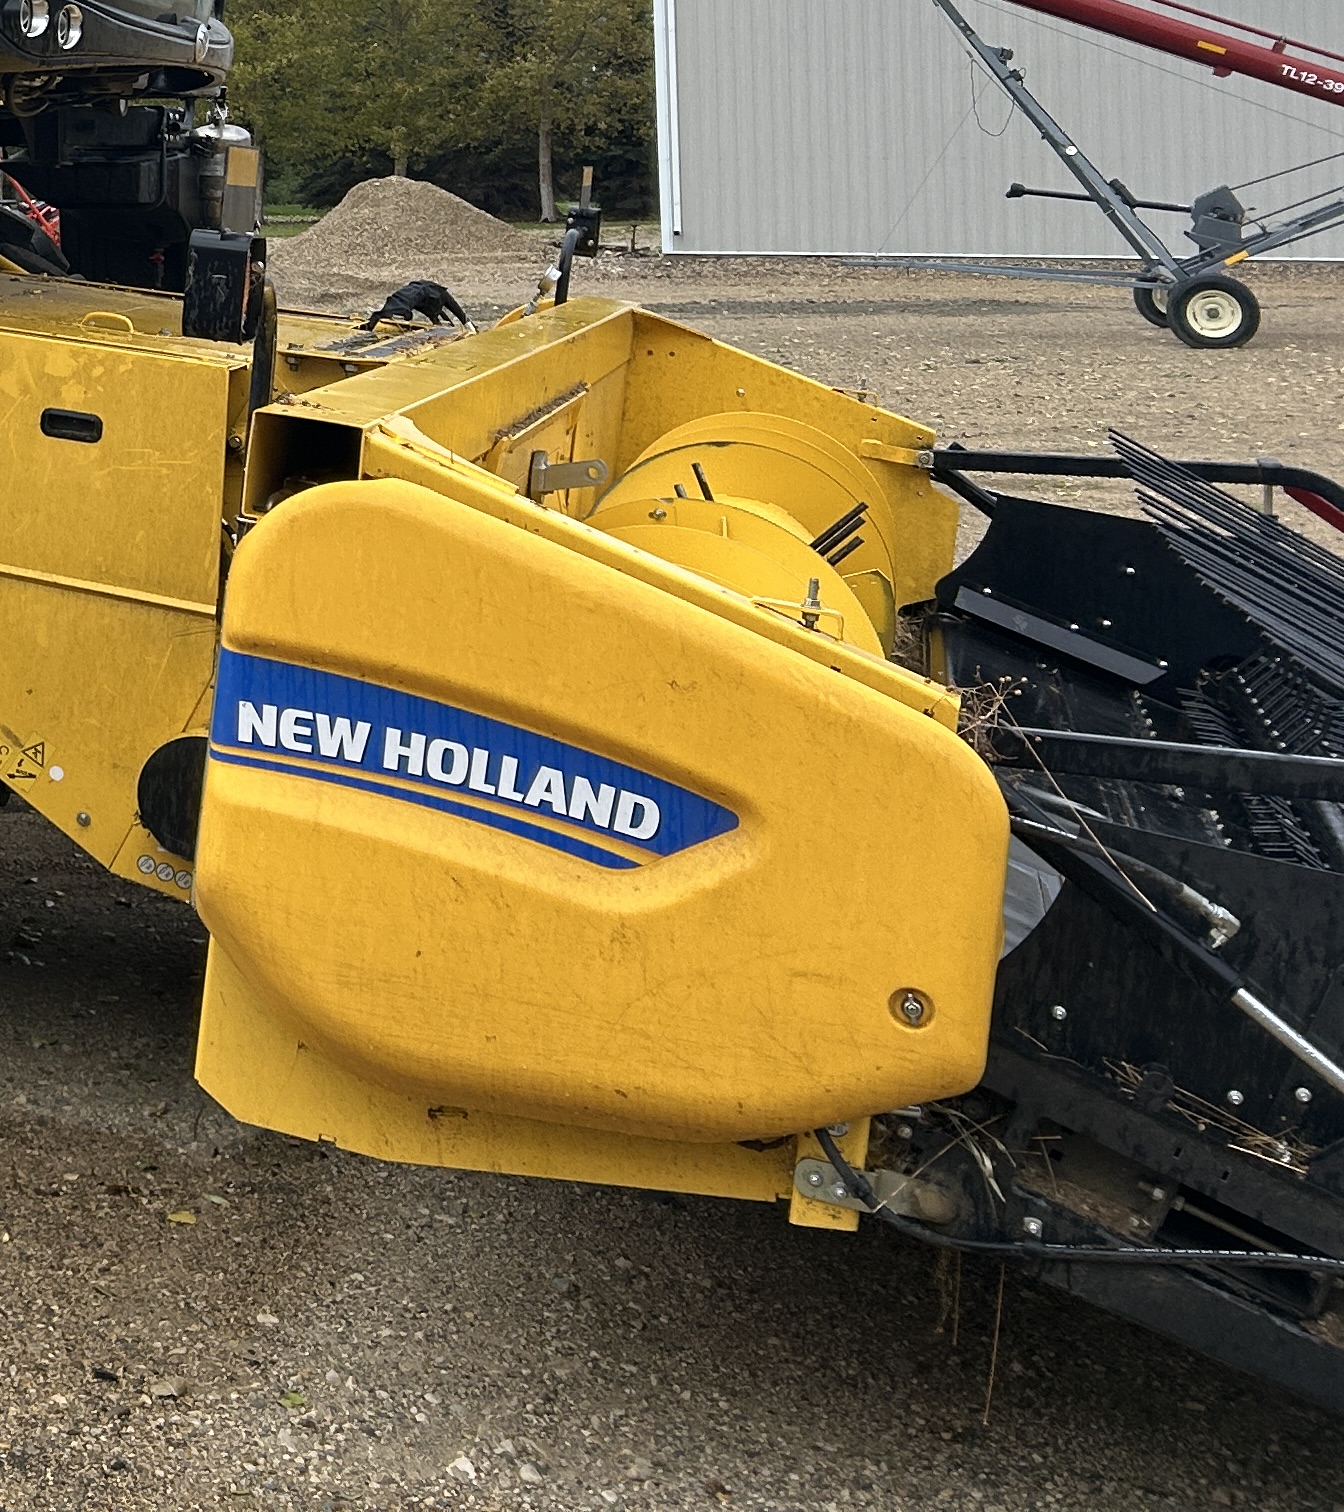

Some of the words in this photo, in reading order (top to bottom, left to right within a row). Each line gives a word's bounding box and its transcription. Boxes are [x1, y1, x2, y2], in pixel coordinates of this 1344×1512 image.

[1281, 63, 1344, 94] TL12-39
[237, 700, 371, 762] NEW
[383, 726, 660, 841] HOLLAND
